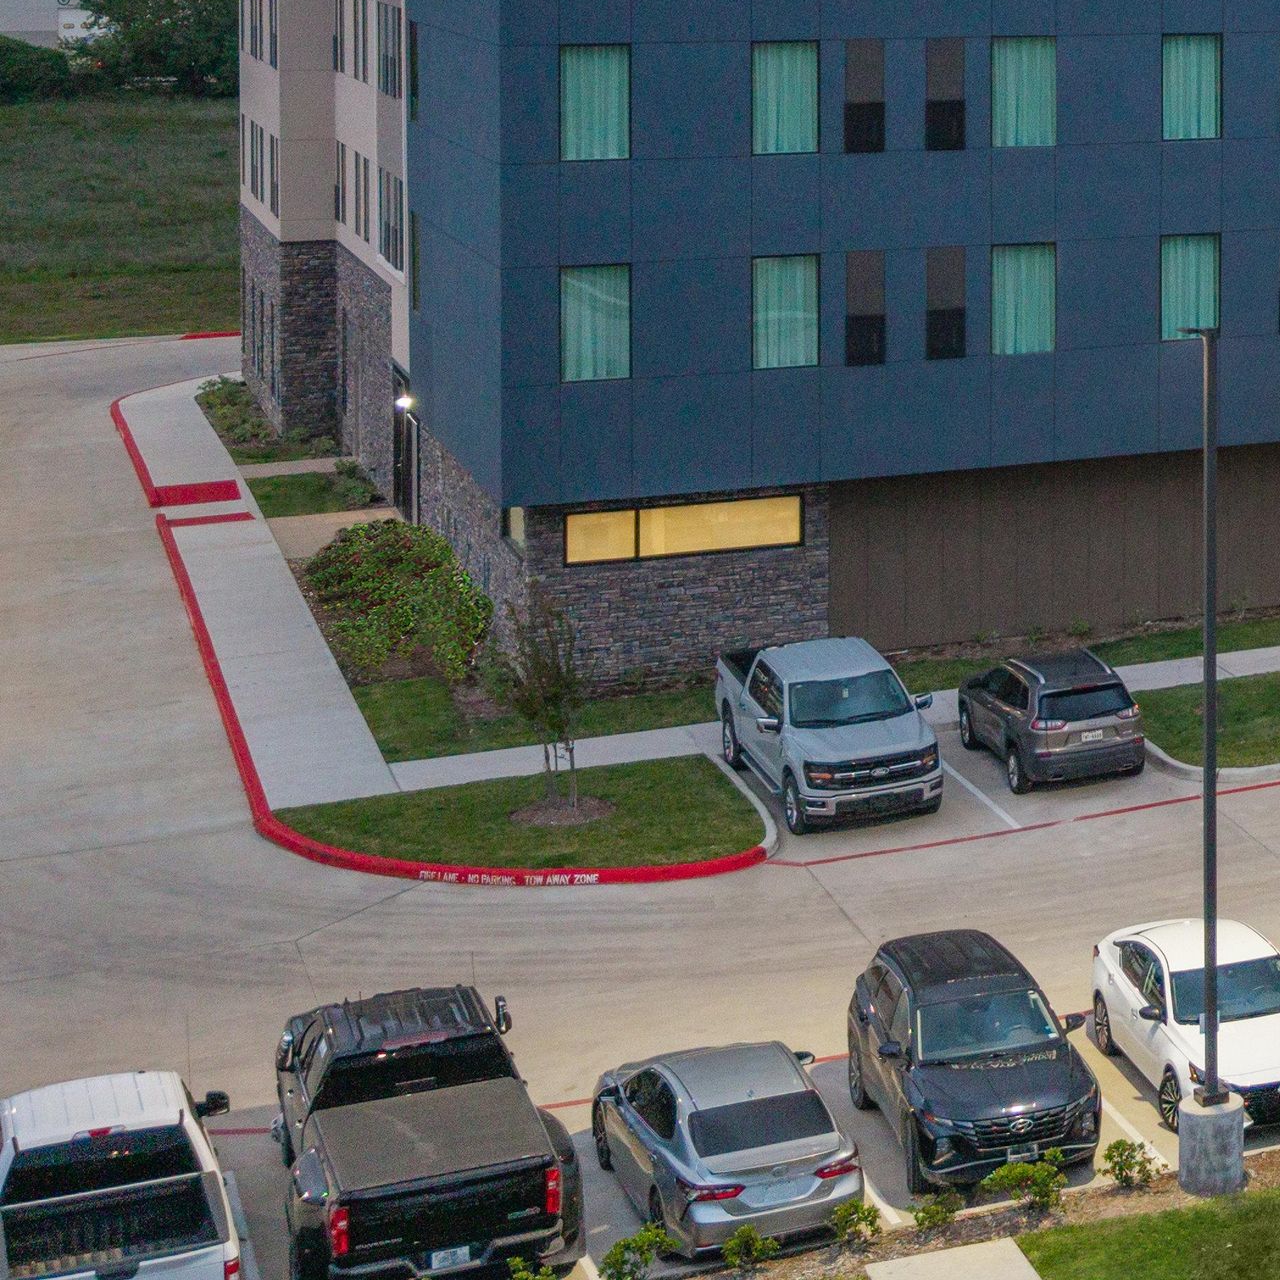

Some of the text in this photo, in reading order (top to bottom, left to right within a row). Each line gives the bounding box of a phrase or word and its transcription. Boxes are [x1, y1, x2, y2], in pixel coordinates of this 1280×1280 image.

[467, 873, 480, 884] NO
[481, 874, 516, 886] PARKING
[523, 875, 543, 885] TOW
[545, 874, 571, 885] AWAY
[573, 873, 599, 885] ZONE
